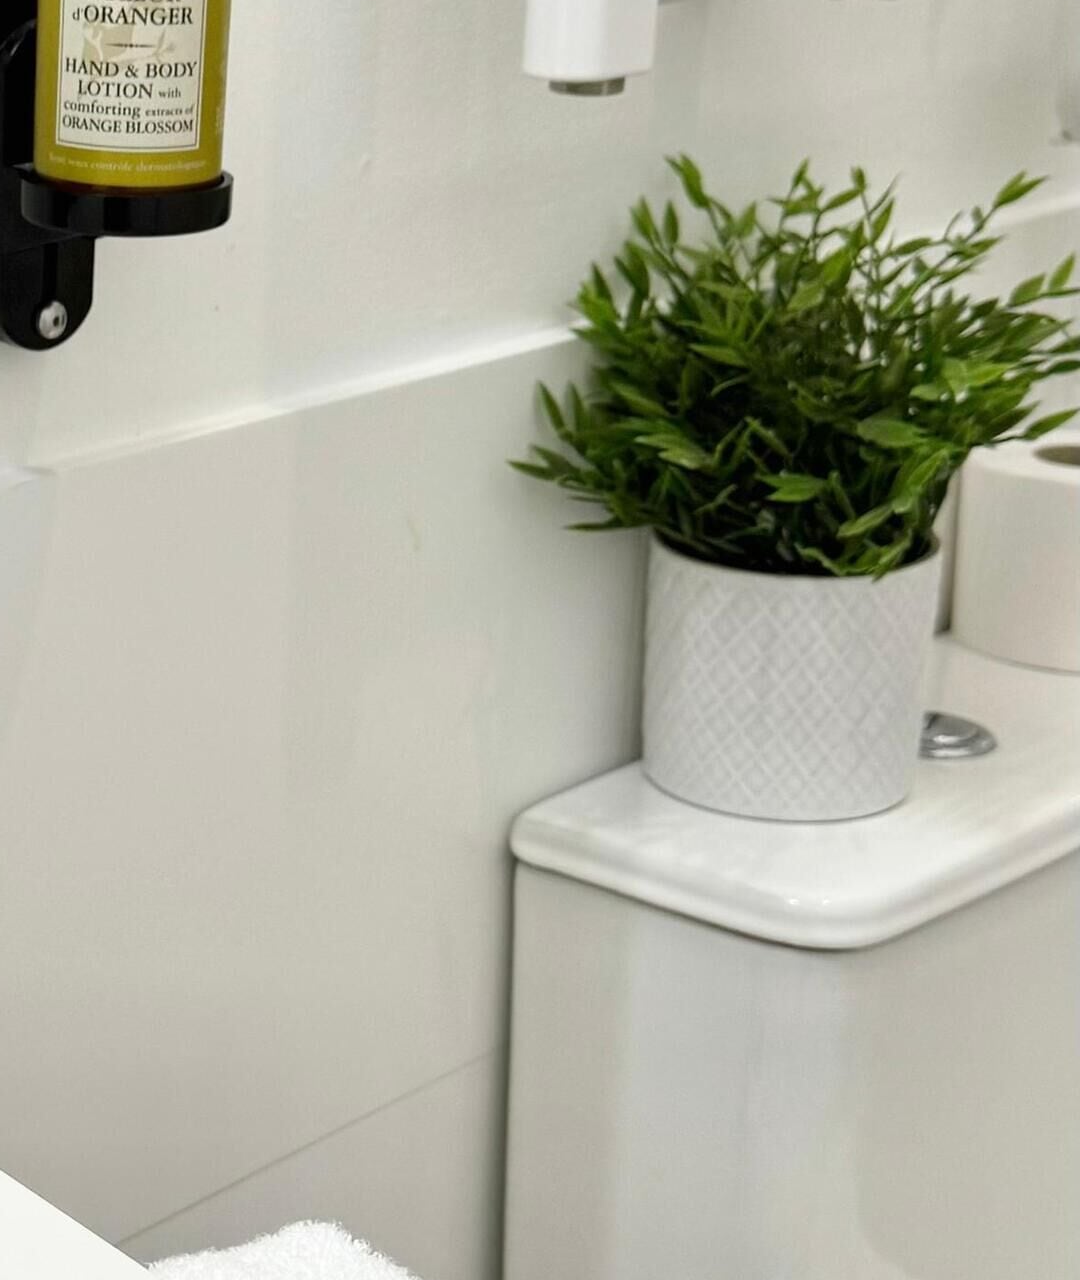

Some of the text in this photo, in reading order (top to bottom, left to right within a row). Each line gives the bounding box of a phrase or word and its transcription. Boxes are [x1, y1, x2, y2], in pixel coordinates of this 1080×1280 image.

[72, 5, 194, 26] d'ORANGER
[65, 58, 197, 78] HAND & BODY
[78, 80, 181, 99] LOTION with
[63, 100, 195, 119] comforting extracts of
[62, 114, 194, 134] ORANGE BLOSSOM
